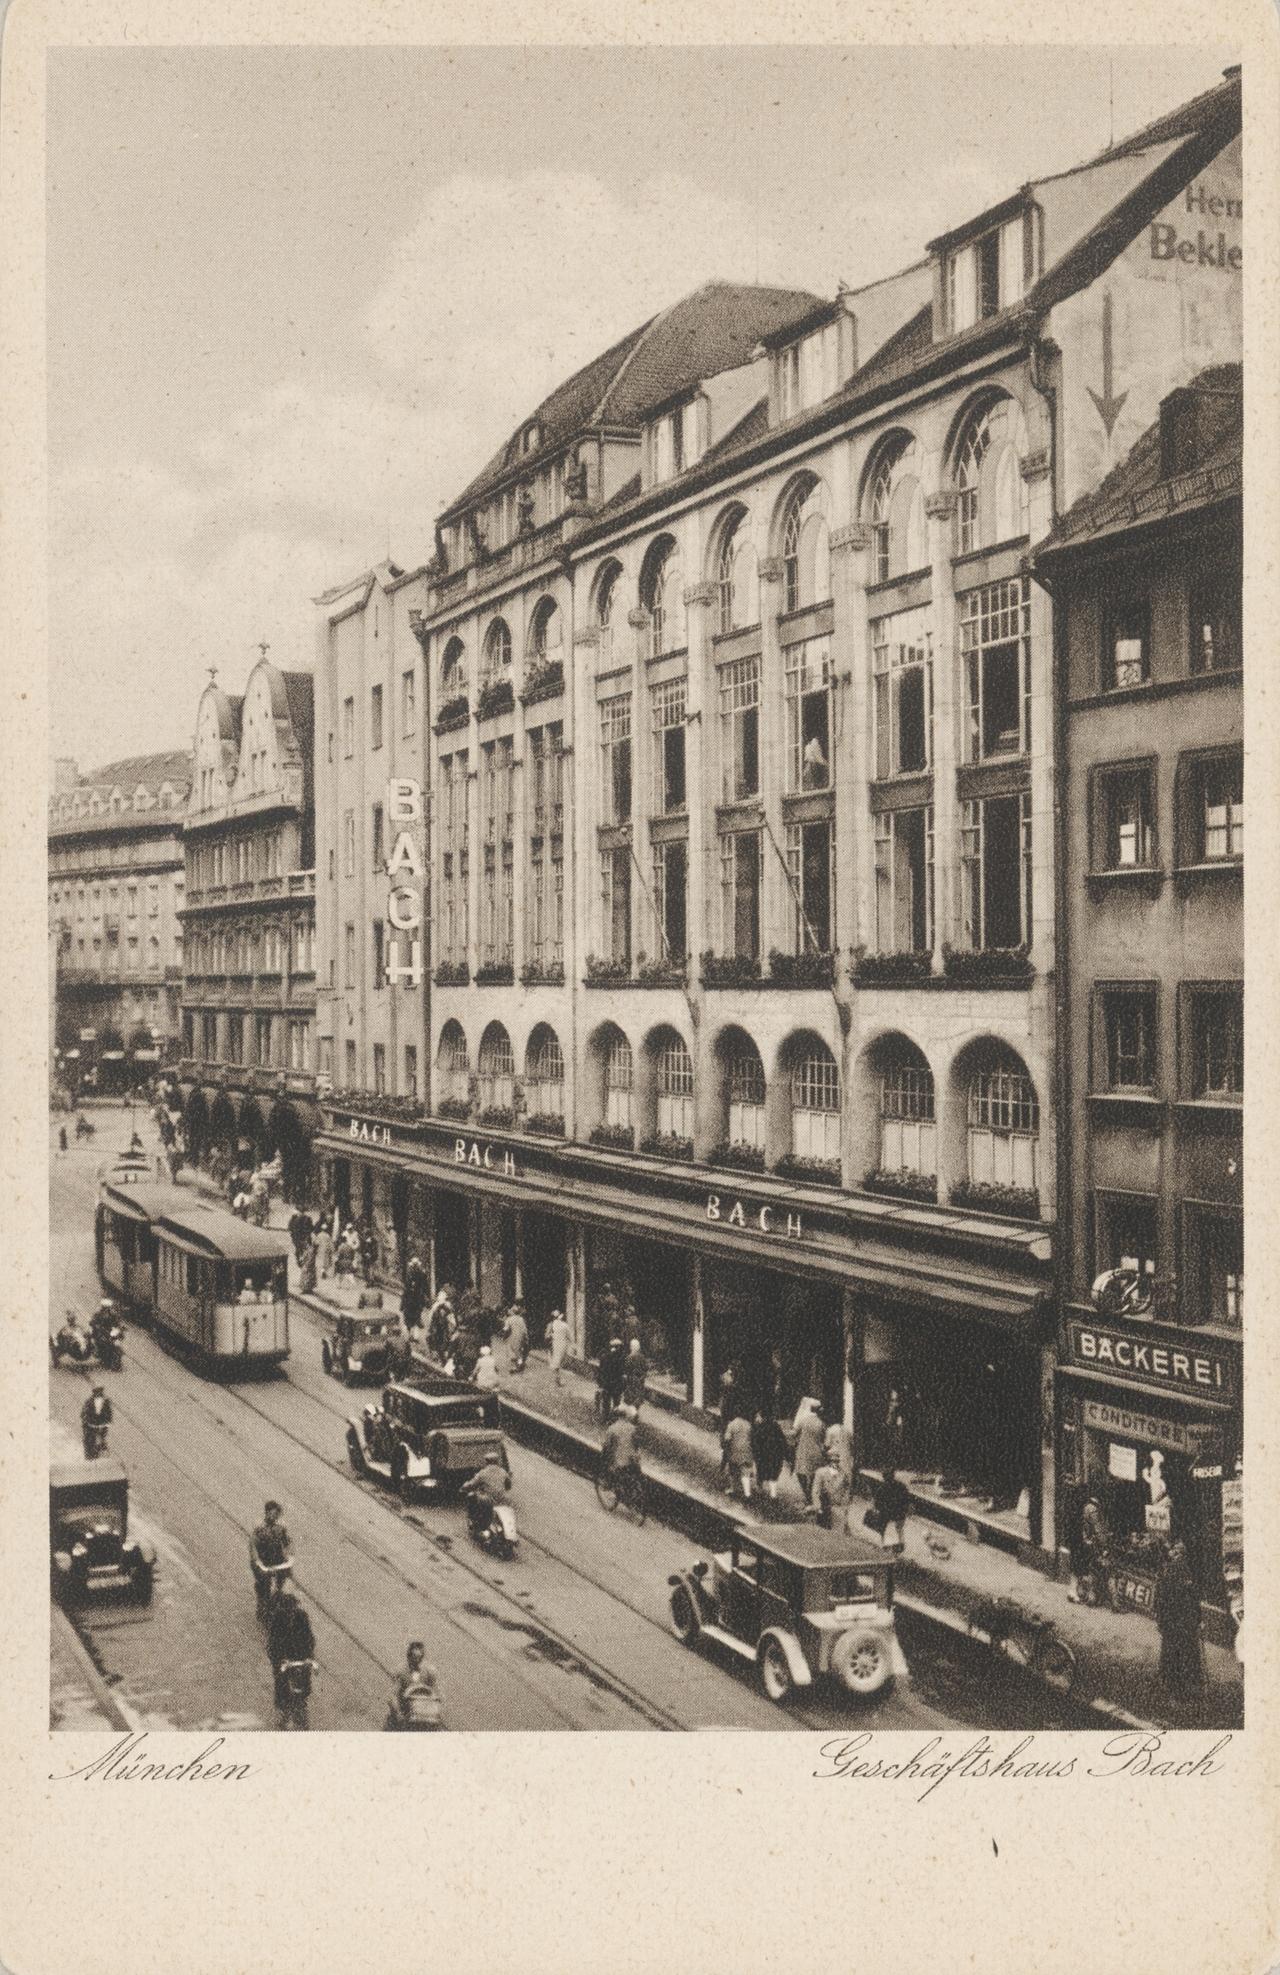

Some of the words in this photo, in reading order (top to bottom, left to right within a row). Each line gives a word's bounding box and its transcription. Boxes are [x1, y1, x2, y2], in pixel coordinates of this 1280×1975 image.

[1151, 222, 1242, 270] Bekle
[386, 777, 424, 985] BACH
[350, 1119, 391, 1145] BACH
[455, 1138, 515, 1176] BACH
[706, 1194, 801, 1238] BACH
[1080, 1332, 1222, 1386] BÄCKEREI
